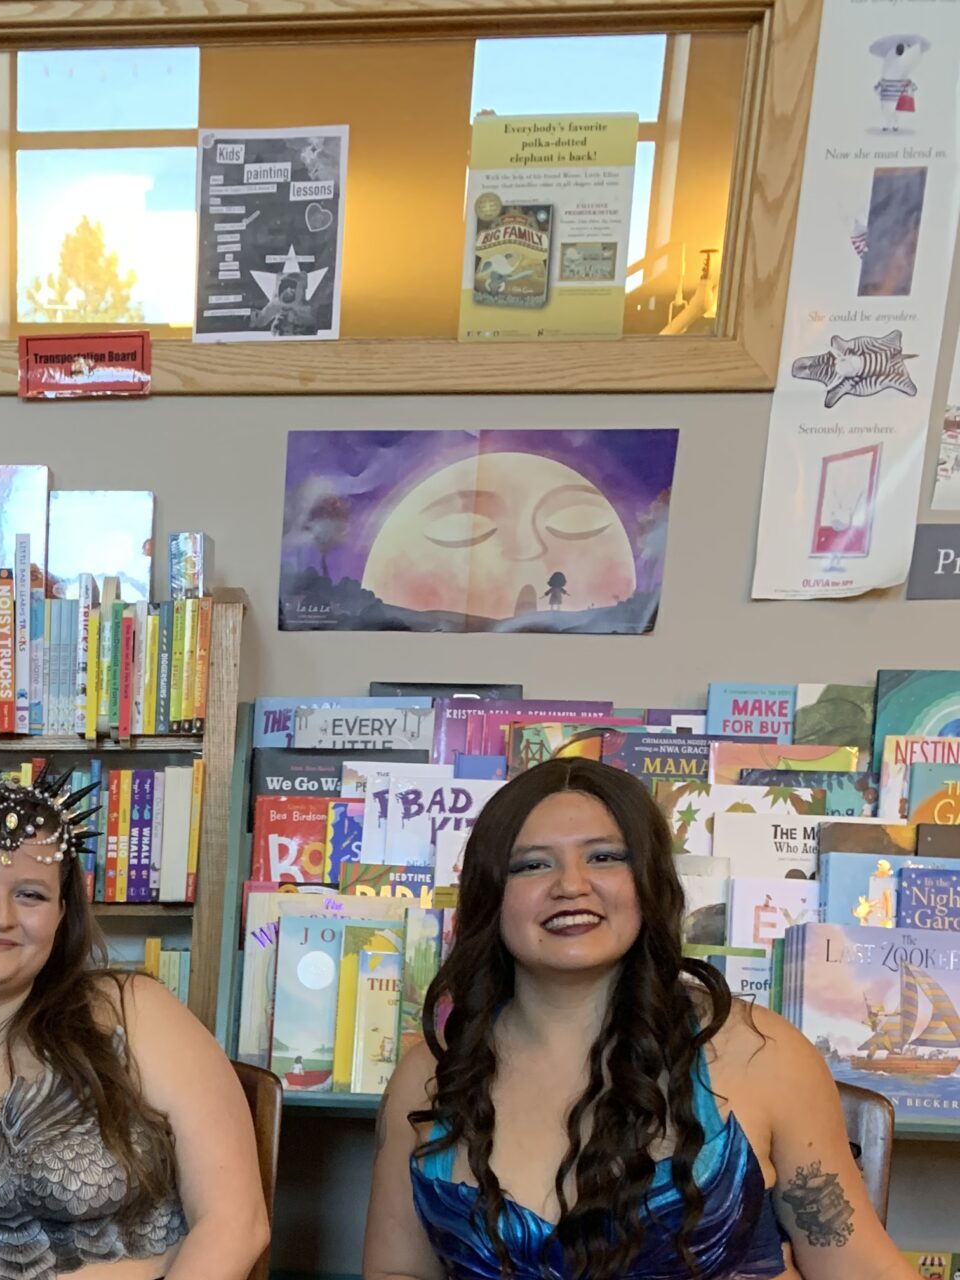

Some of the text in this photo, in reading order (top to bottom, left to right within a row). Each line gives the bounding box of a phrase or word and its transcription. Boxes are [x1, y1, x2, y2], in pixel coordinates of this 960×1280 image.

[247, 165, 290, 182] painting
[292, 183, 334, 199] lessons
[481, 230, 502, 246] BIG
[503, 226, 545, 248] FAMILY
[731, 699, 790, 718] MAKE
[332, 717, 397, 736] EVERY
[722, 719, 755, 735] FOR
[660, 745, 680, 755] NWA
[266, 776, 320, 791] We Go
[395, 787, 474, 822] BAD
[270, 809, 297, 822] Bea
[772, 825, 798, 842] THE
[129, 827, 140, 866] WHALE
[141, 827, 152, 866] WHALE
[390, 872, 433, 883] BEDTIME
[906, 1098, 960, 1110] BECKER
